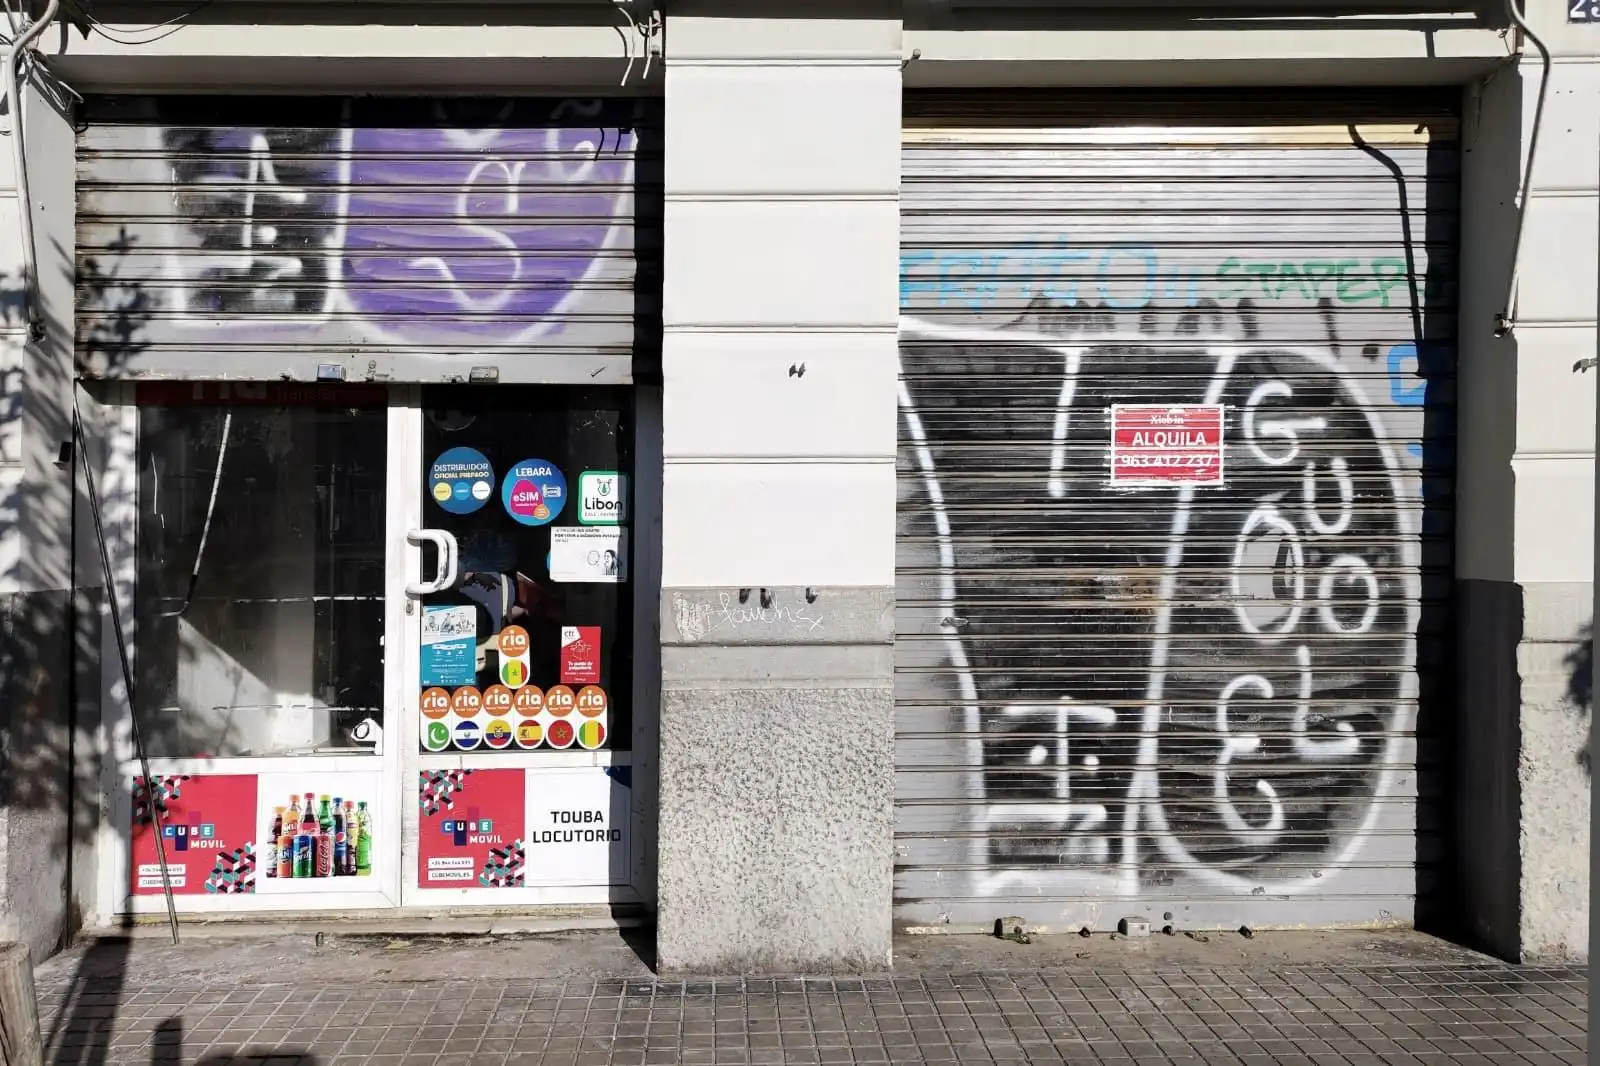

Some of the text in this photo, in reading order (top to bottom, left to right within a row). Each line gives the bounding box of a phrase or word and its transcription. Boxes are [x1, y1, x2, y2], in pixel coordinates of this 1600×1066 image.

[1132, 431, 1206, 449] ALQUILA
[1120, 454, 1148, 467] 963
[434, 463, 489, 472] DISTRIBUIDOR
[515, 467, 553, 477] LEBARA
[584, 497, 623, 510] Libon
[502, 629, 526, 646] ria
[423, 691, 448, 708] ria
[455, 689, 479, 707] ria
[486, 688, 510, 705] ria
[517, 688, 541, 706] ria
[548, 689, 572, 706] ria
[579, 689, 604, 706] ria
[550, 810, 604, 823] TOUBA
[164, 826, 212, 836] CUBE
[443, 821, 489, 831] CUBE
[469, 835, 503, 844] MOVIL
[532, 829, 621, 843] LOCUTORIO
[190, 840, 226, 849] MOVIL
